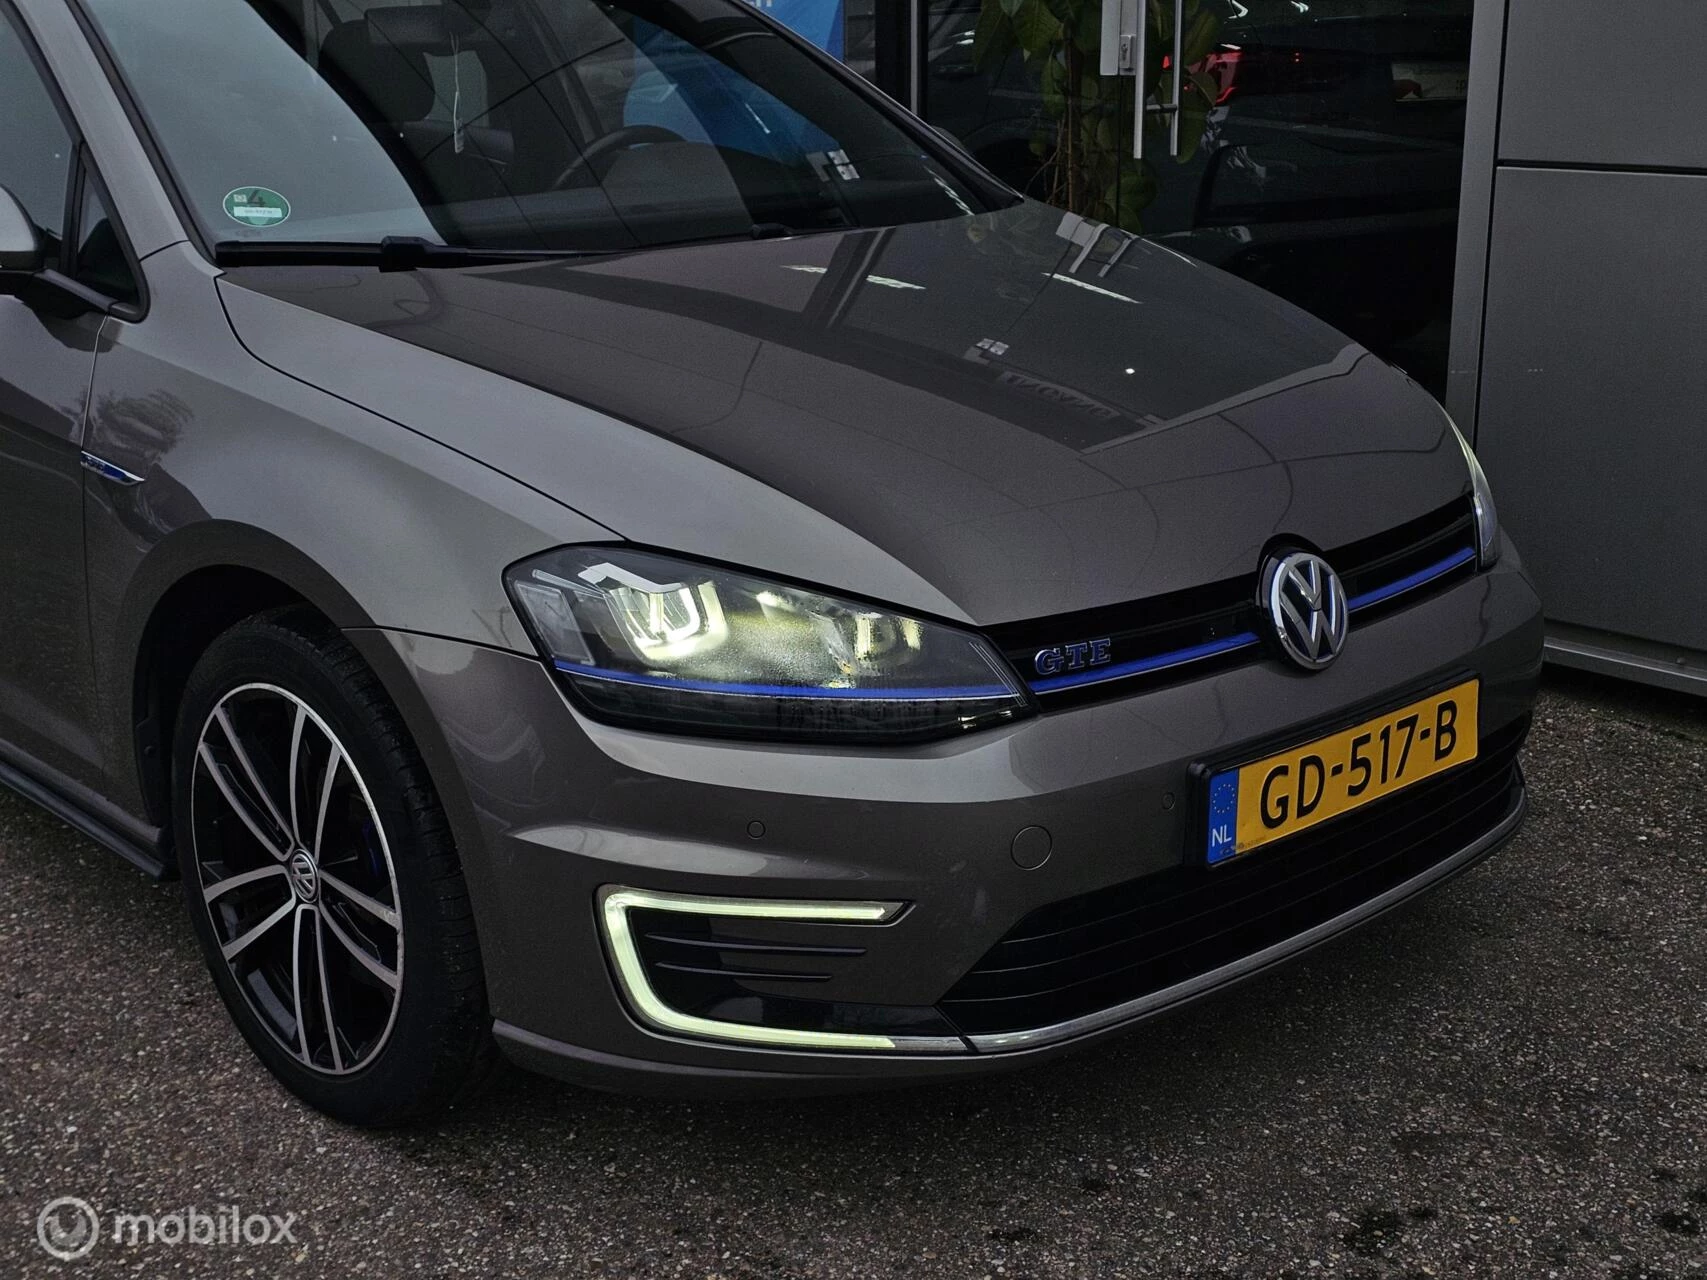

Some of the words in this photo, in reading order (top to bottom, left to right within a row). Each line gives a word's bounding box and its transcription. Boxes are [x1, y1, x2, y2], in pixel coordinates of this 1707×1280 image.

[1275, 555, 1345, 666] VW
[1034, 637, 1112, 676] GTE
[1260, 699, 1458, 829] GD-517-B
[1211, 824, 1232, 847] NL
